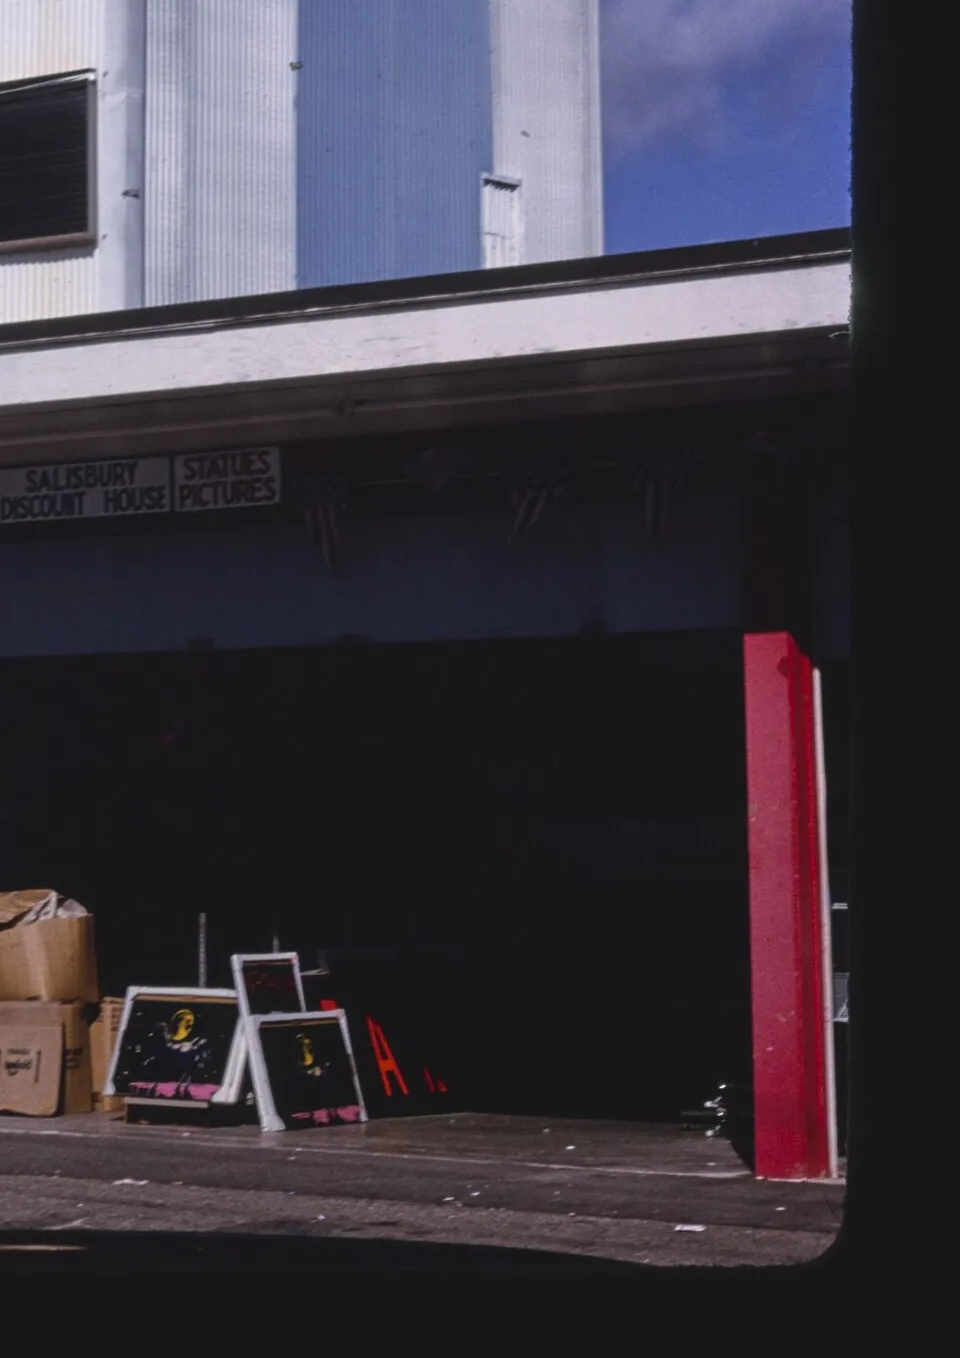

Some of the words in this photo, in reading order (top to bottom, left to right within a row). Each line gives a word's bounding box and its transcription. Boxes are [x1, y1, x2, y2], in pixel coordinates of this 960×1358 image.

[26, 460, 139, 493] SALISBURY
[183, 450, 272, 481] STATUES
[0, 492, 85, 521] DISCOUNT
[103, 485, 167, 514] HOUSE
[178, 477, 278, 509] PICTURES
